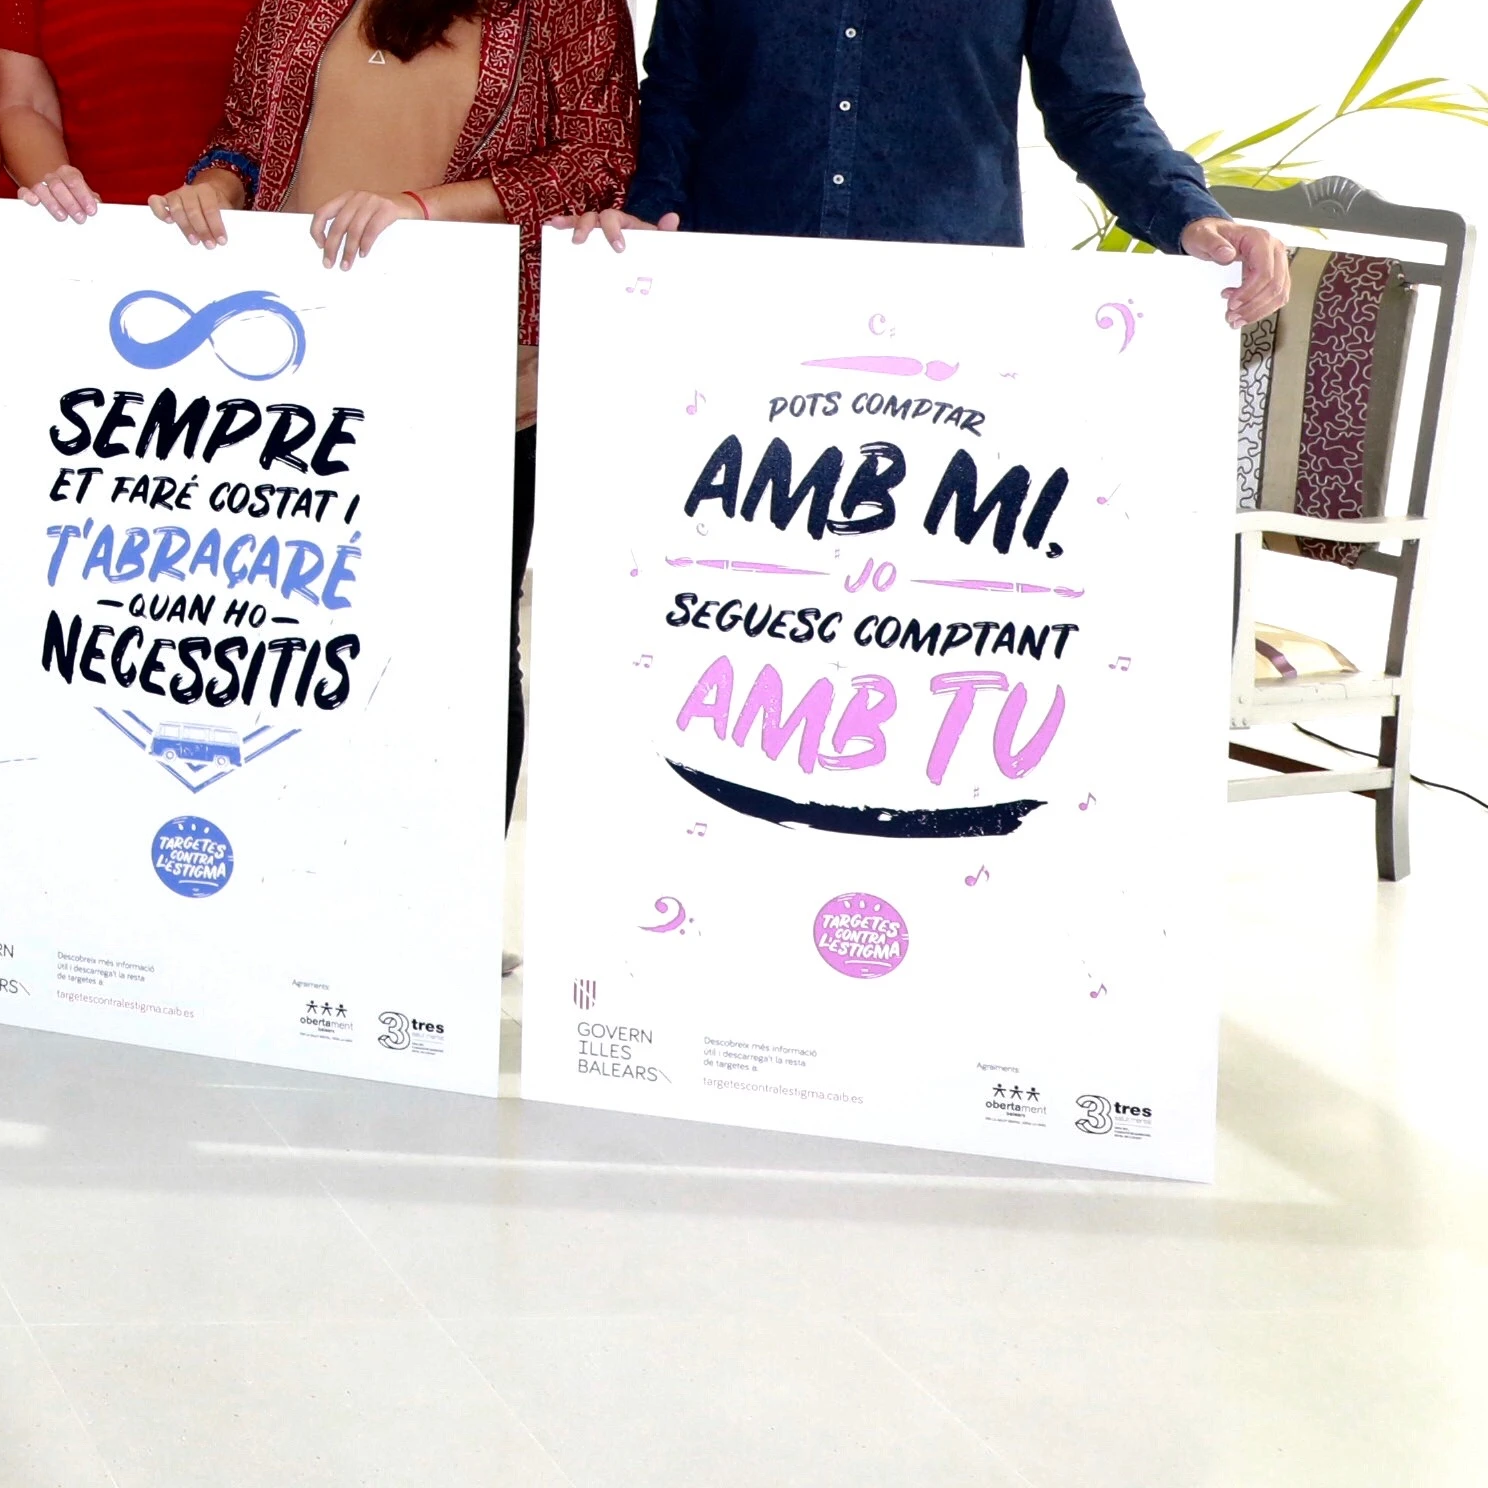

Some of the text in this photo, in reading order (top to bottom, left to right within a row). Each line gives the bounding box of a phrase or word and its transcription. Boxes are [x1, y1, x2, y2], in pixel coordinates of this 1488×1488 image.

[768, 391, 985, 436] POTS COMPTAR
[49, 387, 364, 476] SEMPRE
[49, 467, 360, 523] ET FARÉ COSTAT I
[684, 433, 906, 541] AMB
[46, 517, 362, 610] T'ABRAÇARÉ
[844, 558, 897, 594] JO
[128, 594, 266, 628] QUAN HO
[665, 592, 1079, 660] SEGUESC COMPTANT
[42, 610, 361, 710] NECESSITIS
[676, 654, 1066, 785] AMB TU
[160, 836, 226, 859] TARGETES
[170, 850, 214, 865] CONTRA
[156, 854, 226, 880] L'ESTIGMA
[823, 914, 900, 937] TARGETES
[835, 929, 885, 944] CONTRA
[819, 933, 900, 959] L'ESTIGMA
[300, 1016, 353, 1030] obertament
[411, 1018, 444, 1034] tres
[578, 1022, 652, 1044] GOVERN
[579, 1040, 631, 1060] ILLES
[985, 1100, 1046, 1115] obertament
[1114, 1102, 1152, 1117] tres
